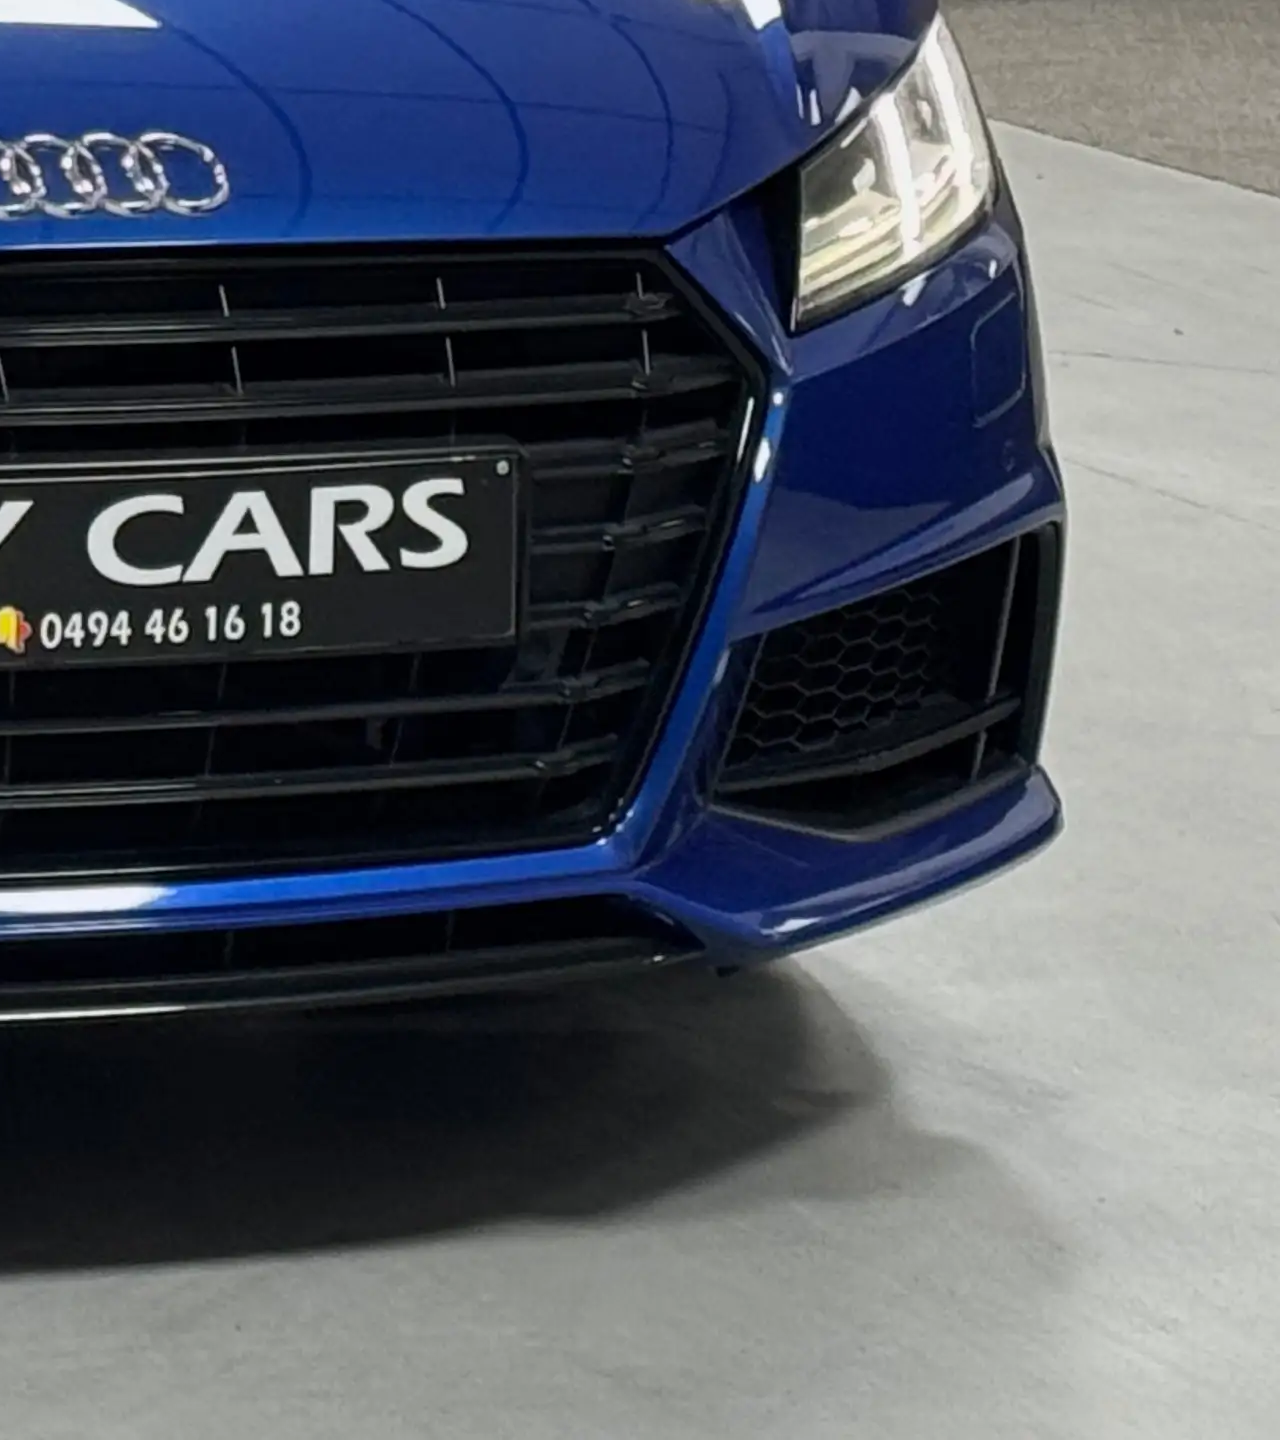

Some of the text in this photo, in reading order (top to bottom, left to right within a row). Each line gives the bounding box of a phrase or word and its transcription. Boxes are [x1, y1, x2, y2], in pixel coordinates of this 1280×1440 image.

[86, 477, 469, 585] CARS
[39, 601, 301, 649] 0494 46 16 18
